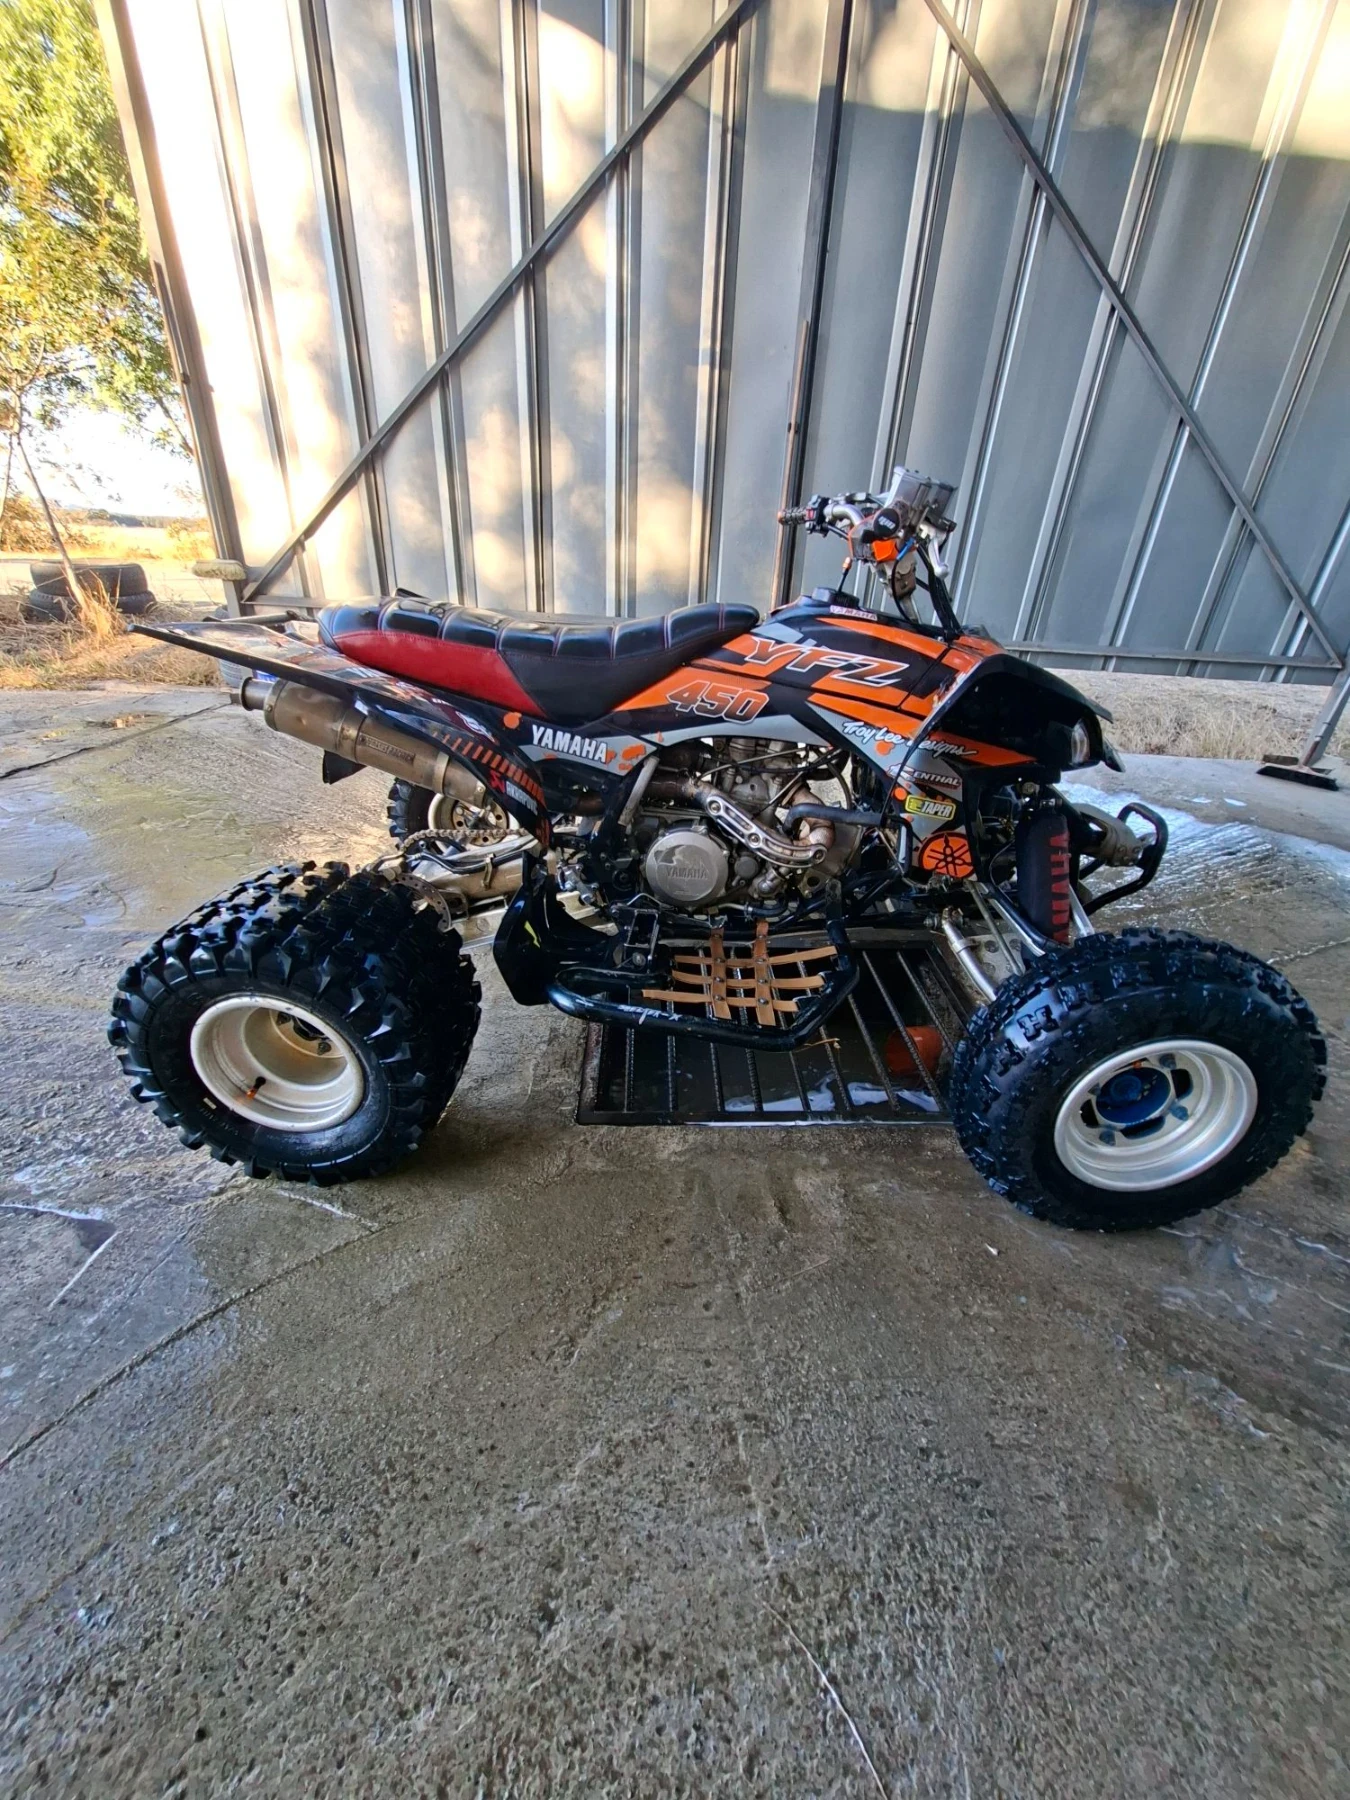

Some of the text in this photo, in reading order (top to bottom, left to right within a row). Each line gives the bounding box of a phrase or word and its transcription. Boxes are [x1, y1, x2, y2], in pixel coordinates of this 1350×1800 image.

[744, 636, 909, 687] YFZ
[666, 680, 769, 724] 450
[532, 724, 607, 763] YAMAHA
[842, 721, 876, 744] Troy
[875, 727, 904, 745] Lee
[922, 801, 953, 817] TAPER
[666, 867, 708, 879] YAMAHA
